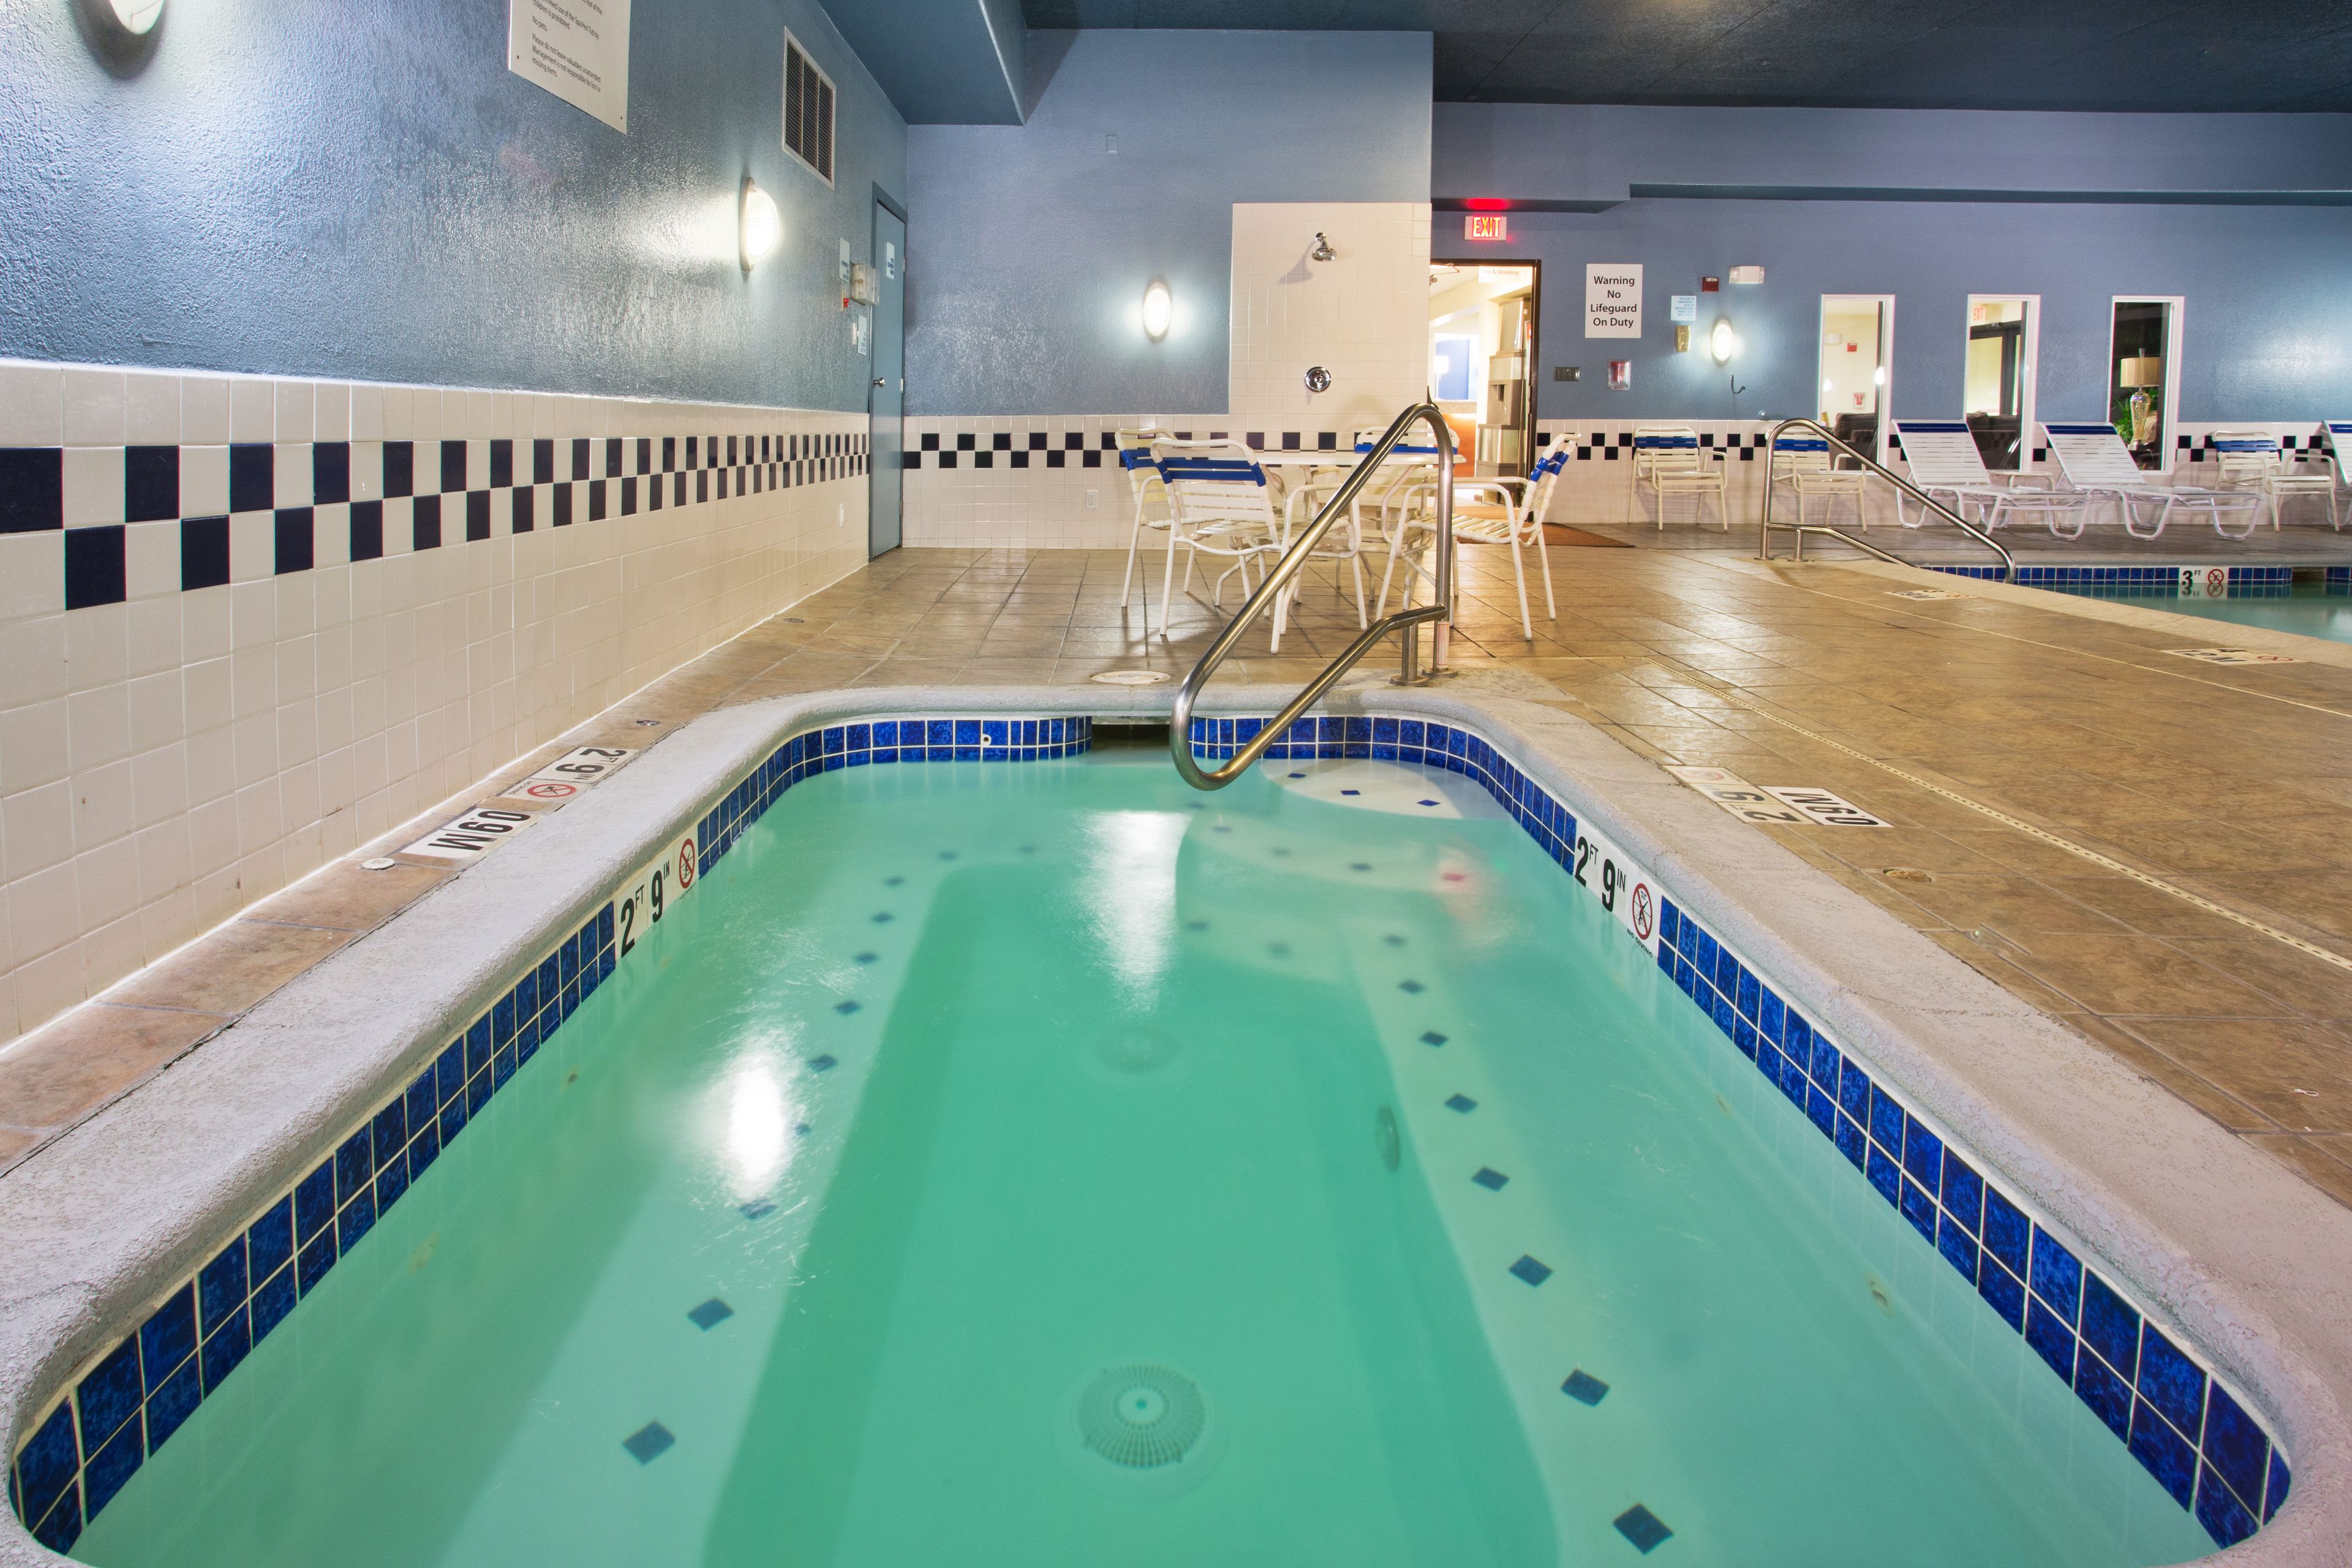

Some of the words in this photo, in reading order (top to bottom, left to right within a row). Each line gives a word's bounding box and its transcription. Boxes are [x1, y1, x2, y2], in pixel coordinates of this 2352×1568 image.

[532, 15, 538, 25] No
[595, 30, 600, 40] by
[532, 33, 544, 47] Please
[545, 41, 550, 50] do
[557, 49, 567, 61] leave
[567, 56, 582, 71] valuables
[532, 44, 557, 66] Management
[567, 68, 586, 84] responsible
[532, 58, 547, 72] missing
[1472, 216, 1501, 238] EXIT
[1594, 276, 1635, 287] Warning
[1607, 290, 1621, 299] No
[1590, 303, 1637, 314] Lifeguard
[1973, 307, 1984, 320] EXIT
[1593, 317, 1607, 326] On
[1610, 317, 1634, 328] Duty
[1627, 928, 1634, 939] NO
[1635, 937, 1653, 959] DIVING
